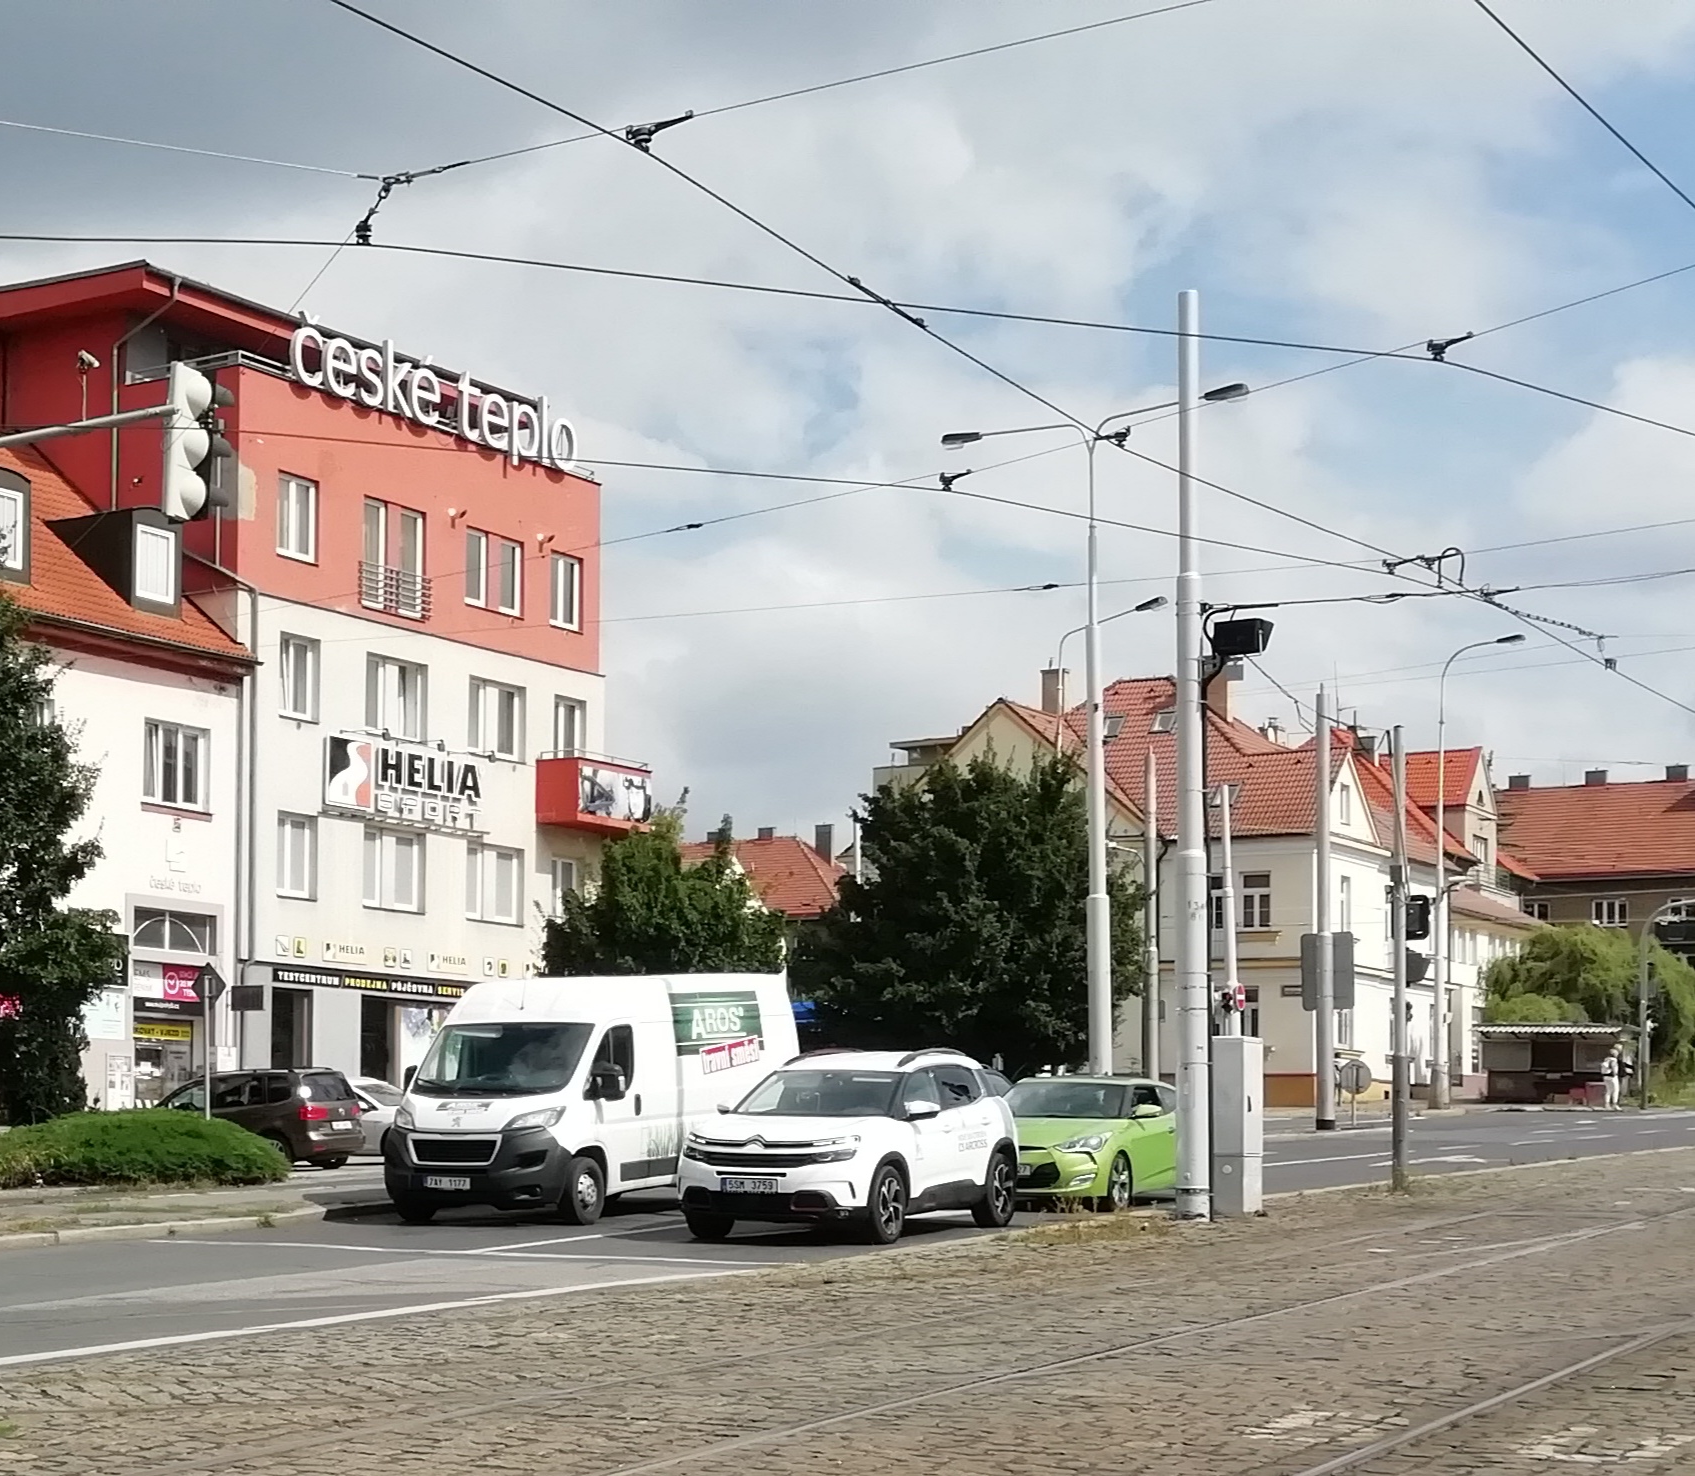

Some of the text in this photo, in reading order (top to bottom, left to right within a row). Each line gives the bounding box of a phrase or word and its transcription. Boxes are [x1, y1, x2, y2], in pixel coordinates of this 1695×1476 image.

[290, 310, 578, 470] české teplo
[380, 747, 482, 799] HELIA
[378, 793, 483, 829] SPORT
[339, 944, 365, 955] HELIA
[442, 955, 466, 966] HELIA
[277, 971, 465, 996] TESTCENTRUM PRODEJNA PŮJČOVNA SERVIS
[701, 1044, 731, 1074] travní
